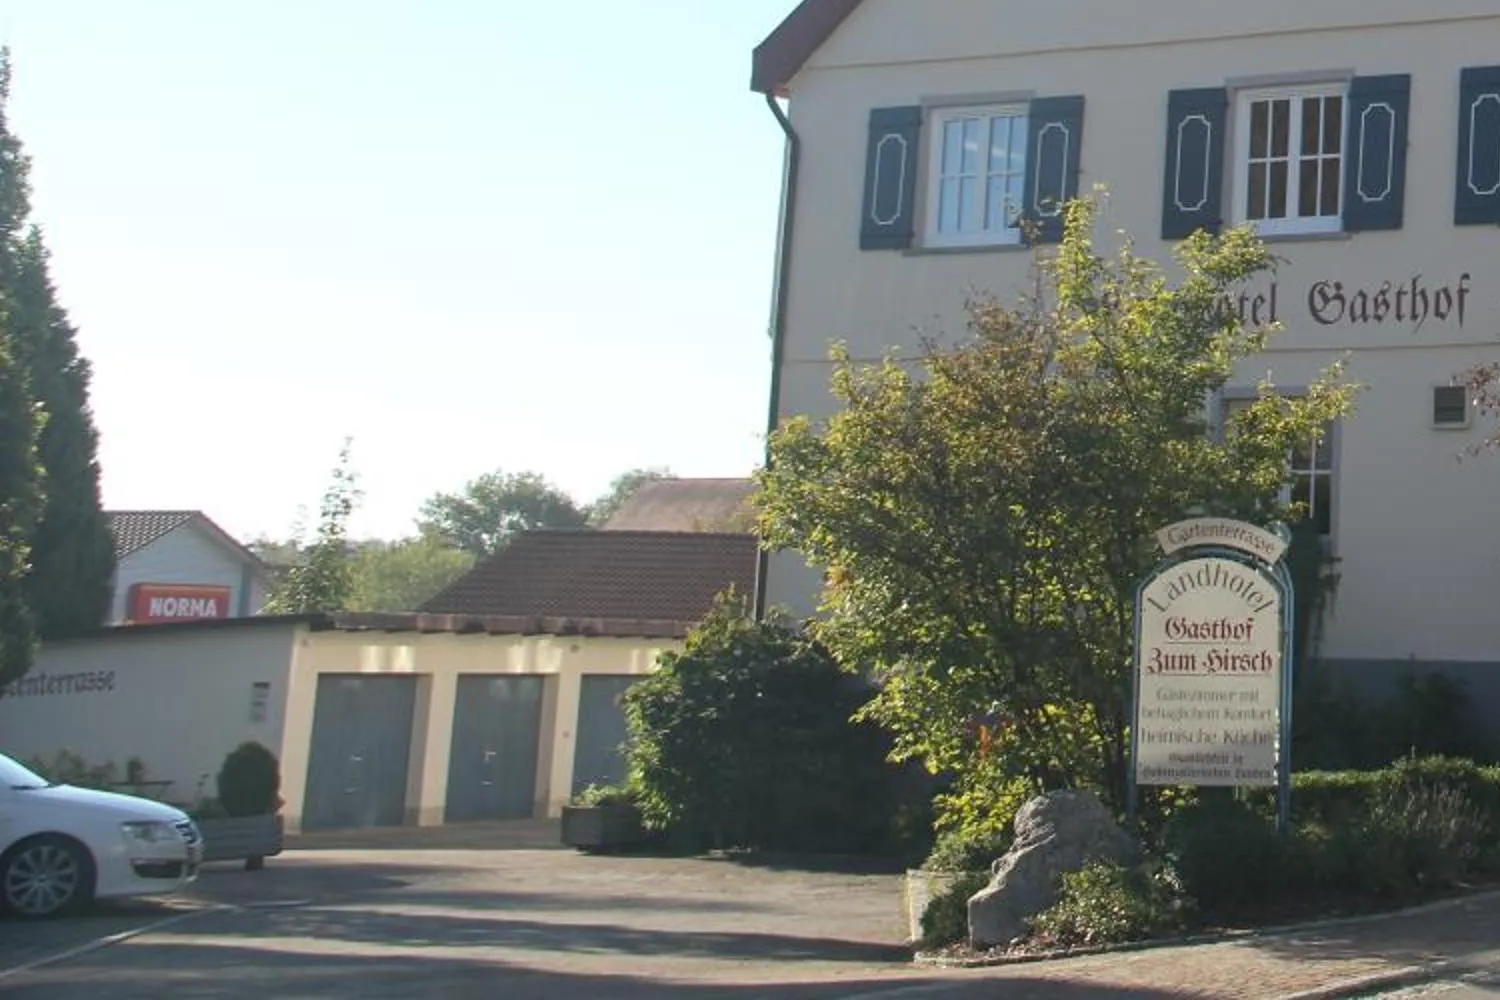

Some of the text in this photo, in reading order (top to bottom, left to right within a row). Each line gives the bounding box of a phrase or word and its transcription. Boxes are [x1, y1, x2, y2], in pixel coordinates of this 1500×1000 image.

[1308, 273, 1471, 334] Gasthof
[1147, 563, 1274, 613] Landhotel
[149, 597, 218, 618] NORMA
[1165, 616, 1254, 642] Gasthof
[1147, 648, 1273, 674] Zum Hirsch
